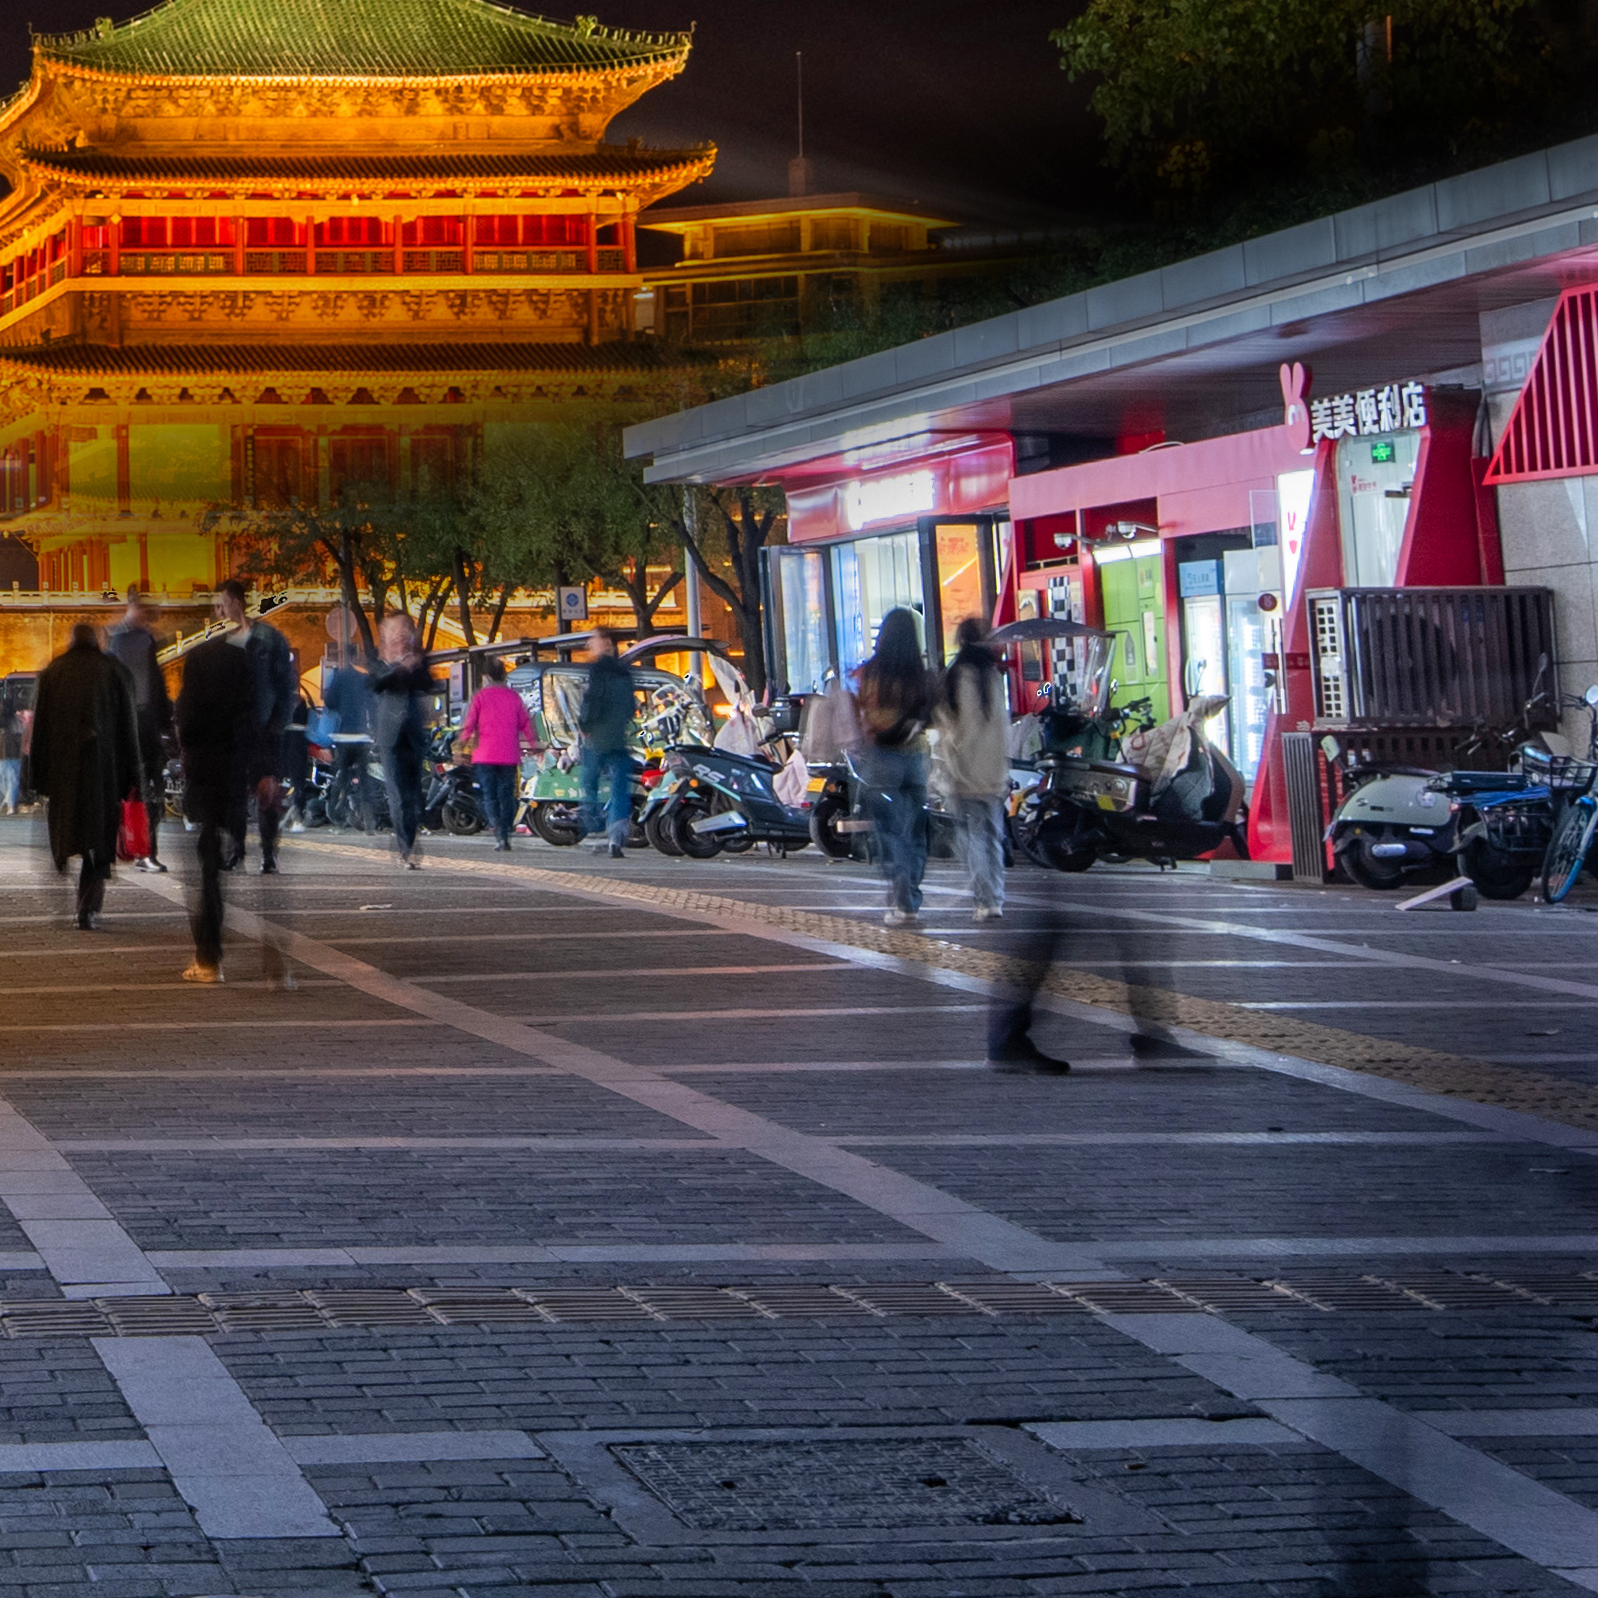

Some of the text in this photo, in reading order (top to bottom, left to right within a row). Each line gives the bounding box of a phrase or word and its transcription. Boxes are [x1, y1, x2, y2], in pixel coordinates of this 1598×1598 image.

[1311, 382, 1426, 443] 美美便利店
[692, 763, 726, 784] RS
